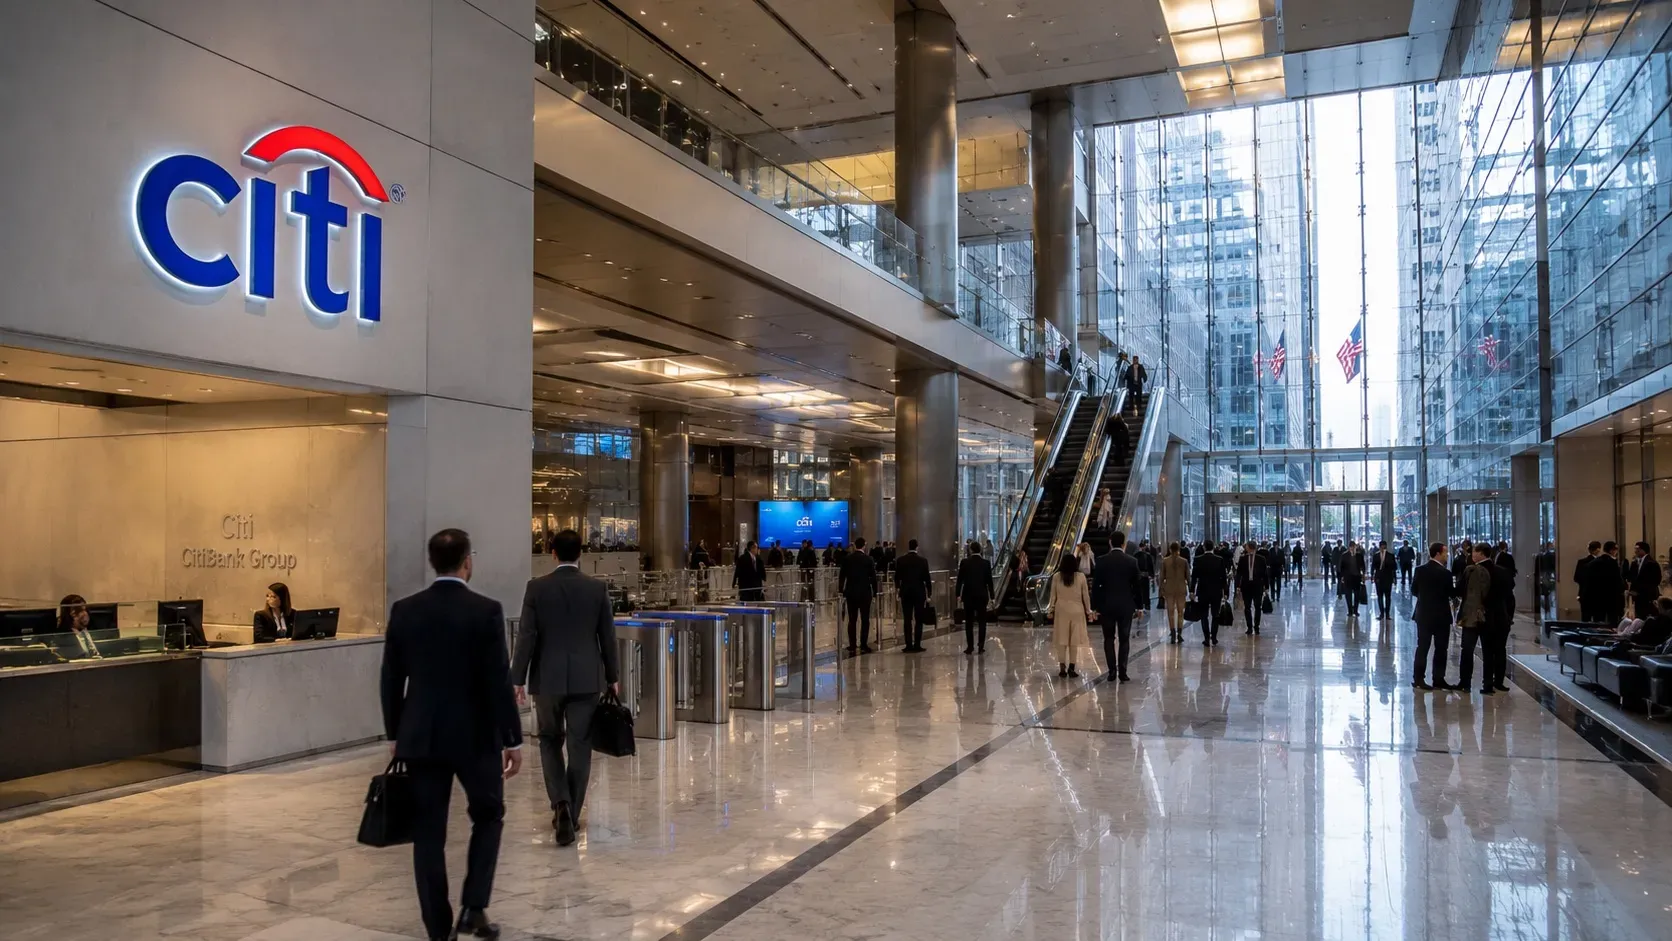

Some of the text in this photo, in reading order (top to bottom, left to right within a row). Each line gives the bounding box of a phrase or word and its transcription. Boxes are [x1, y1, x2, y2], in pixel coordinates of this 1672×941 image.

[135, 153, 383, 323] citi
[221, 514, 254, 540] Citi
[182, 547, 298, 577] CitiBank Group
